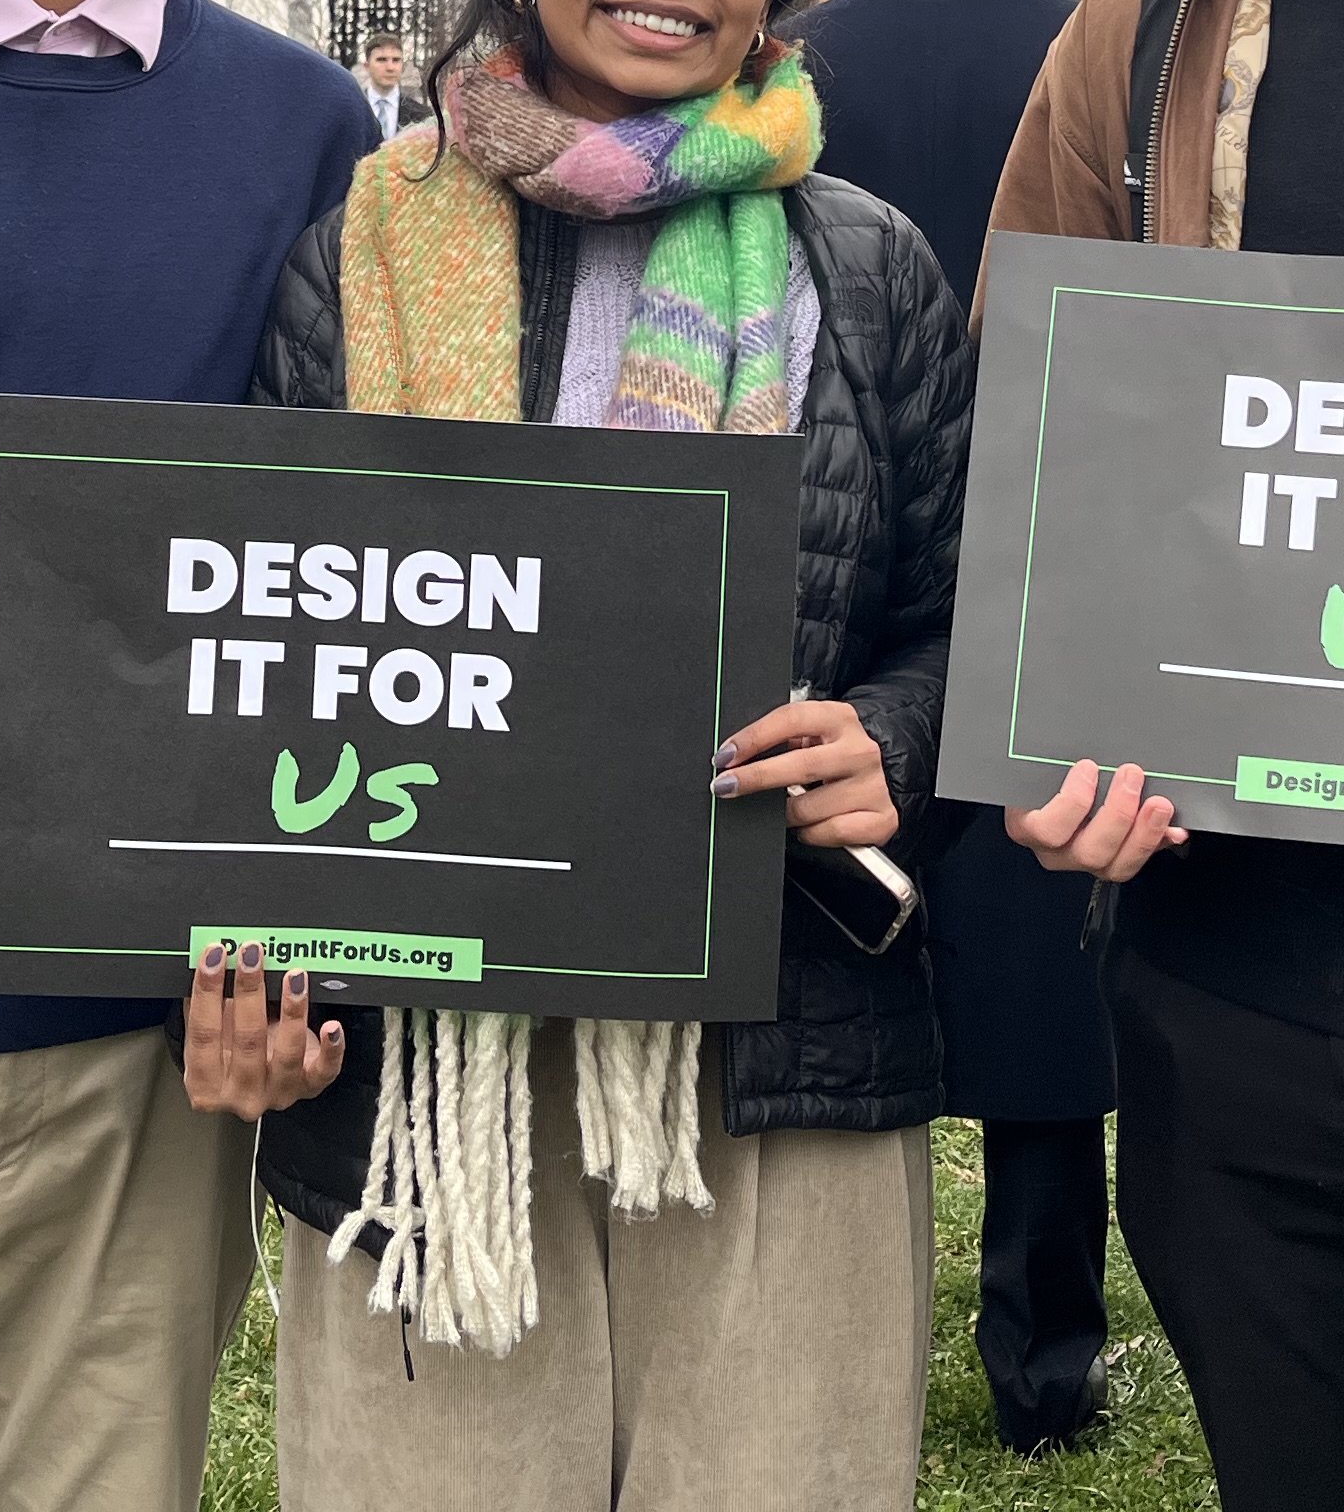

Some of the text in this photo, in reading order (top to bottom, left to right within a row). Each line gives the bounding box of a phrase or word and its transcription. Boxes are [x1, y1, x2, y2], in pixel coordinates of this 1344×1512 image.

[1238, 471, 1338, 551] IT
[166, 537, 542, 633] DESIGN
[187, 638, 513, 732] IT FOR
[220, 936, 453, 973] DignItForUs.org
